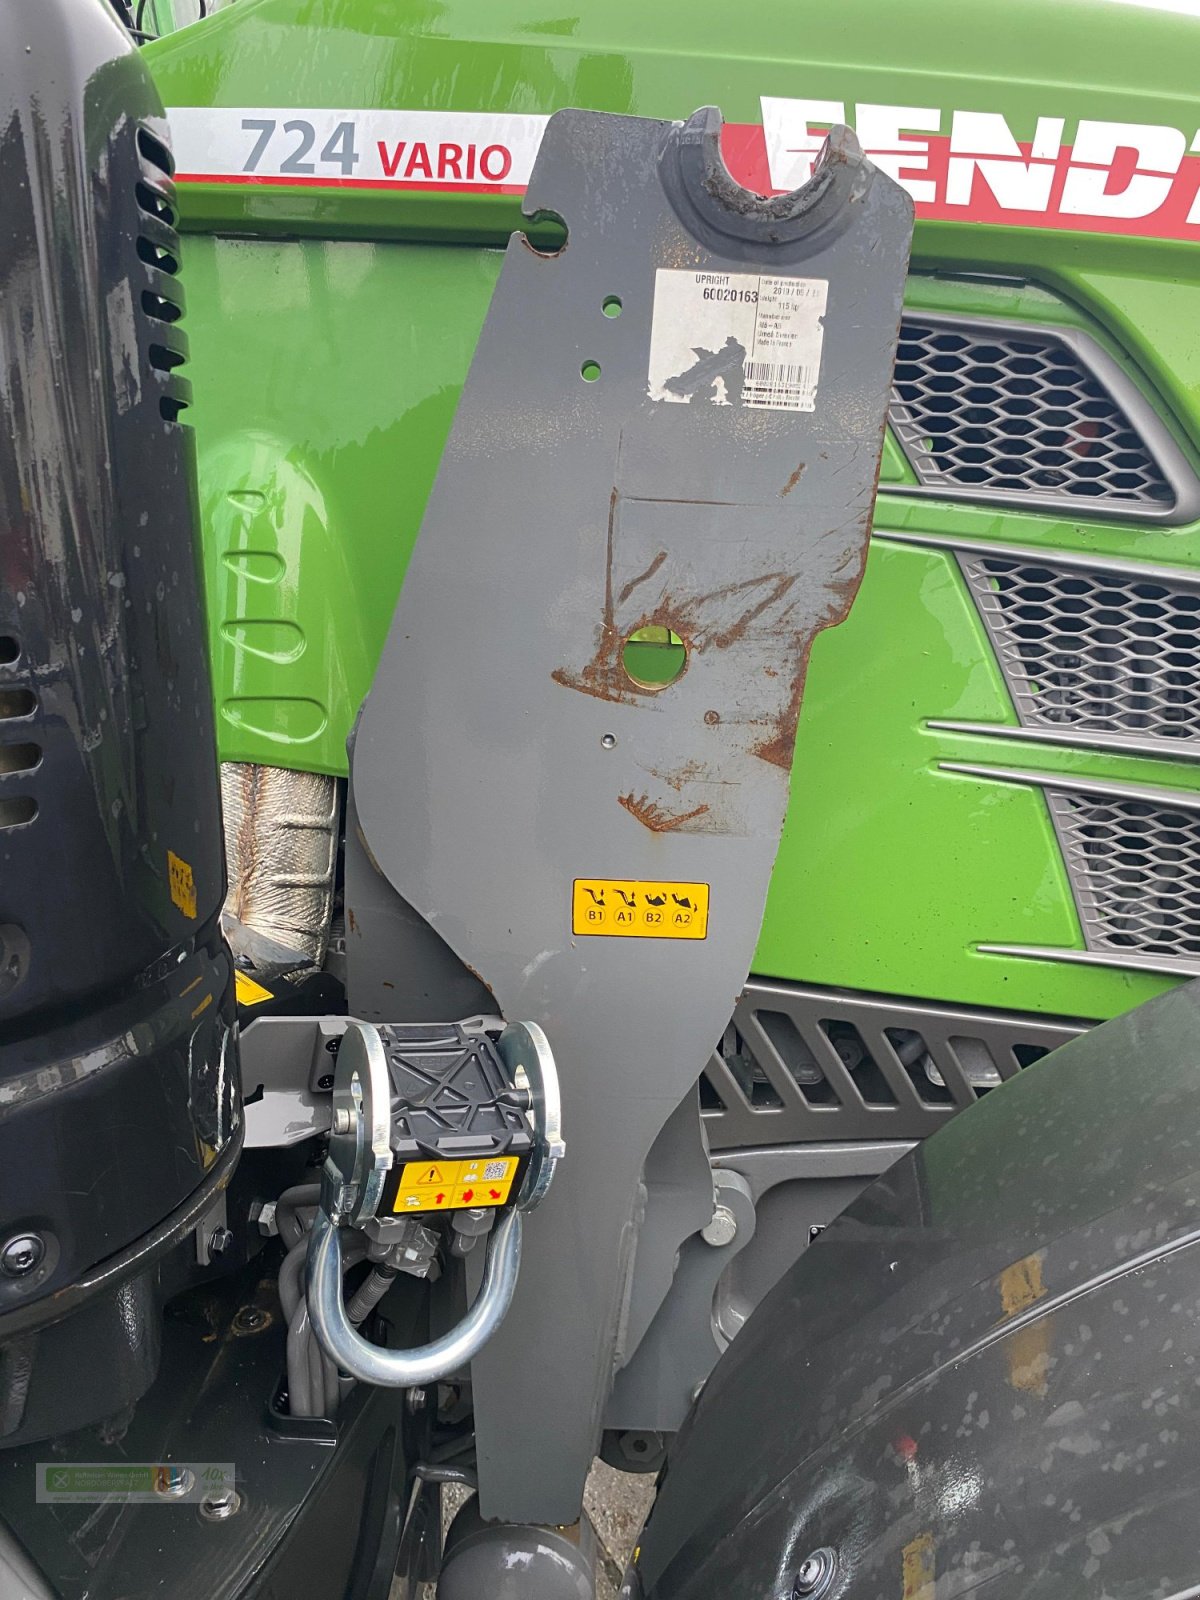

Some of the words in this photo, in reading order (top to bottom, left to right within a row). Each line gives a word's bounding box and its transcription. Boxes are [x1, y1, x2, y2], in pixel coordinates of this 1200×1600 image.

[241, 119, 359, 175] 724
[377, 141, 512, 181] VARIO
[760, 96, 1200, 224] FEND
[695, 274, 730, 286] UPRIGHT
[703, 287, 758, 303] 60020163
[588, 911, 603, 921] B1
[617, 912, 633, 922] A1
[646, 913, 661, 923] B2
[675, 914, 691, 923] A2
